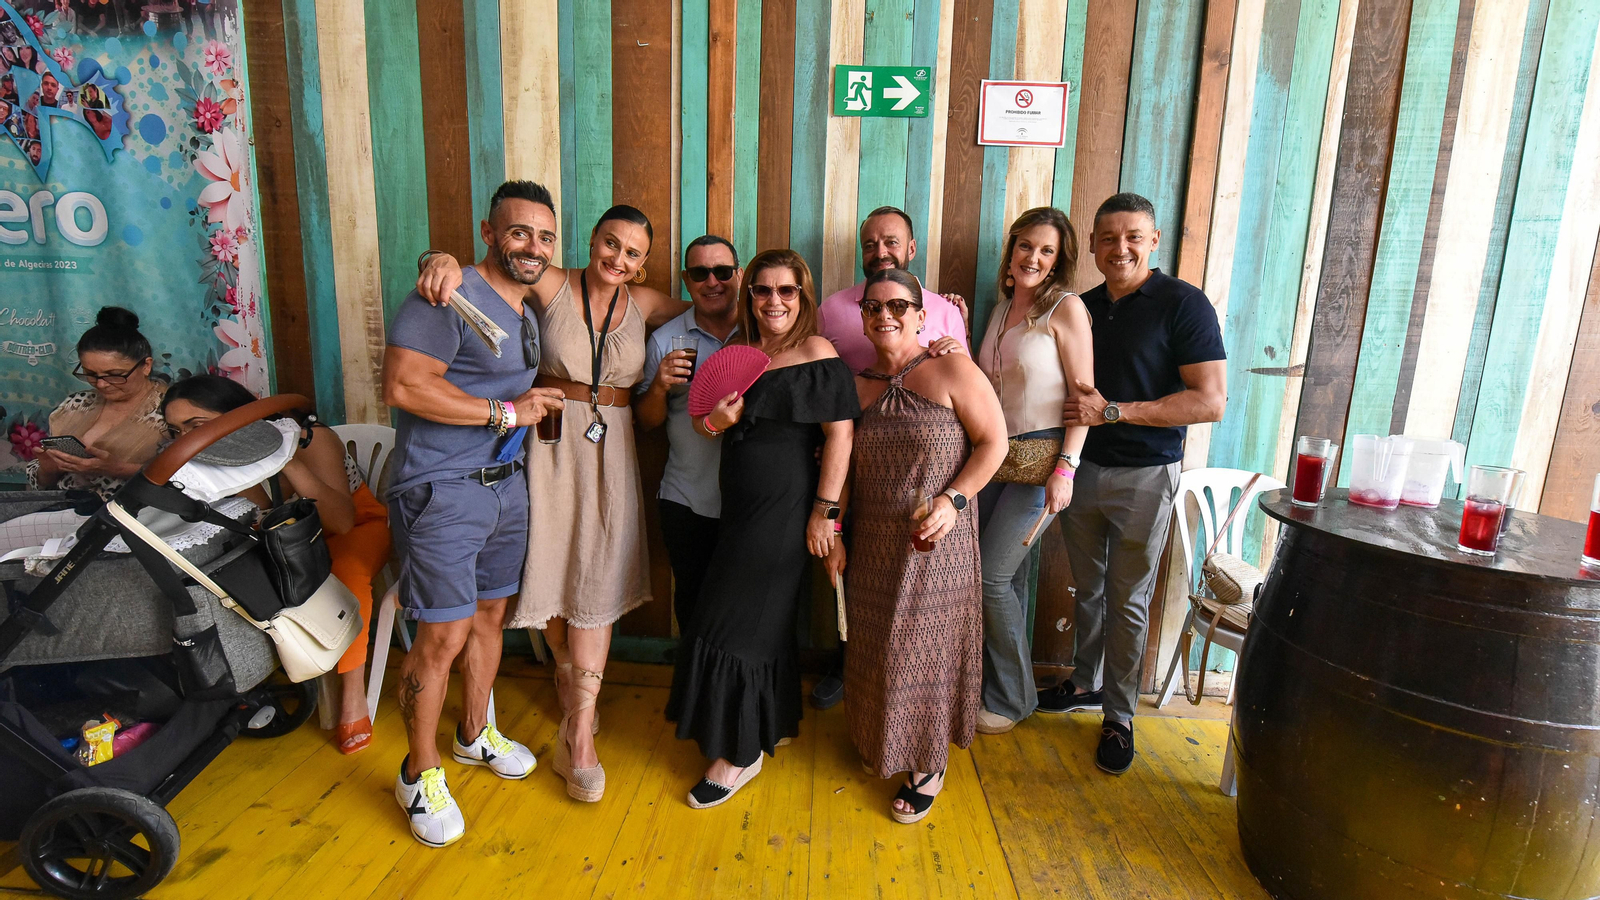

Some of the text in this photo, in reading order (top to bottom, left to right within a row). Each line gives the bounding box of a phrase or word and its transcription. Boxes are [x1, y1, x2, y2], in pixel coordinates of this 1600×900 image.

[4, 259, 78, 270] de Algeciras 2023
